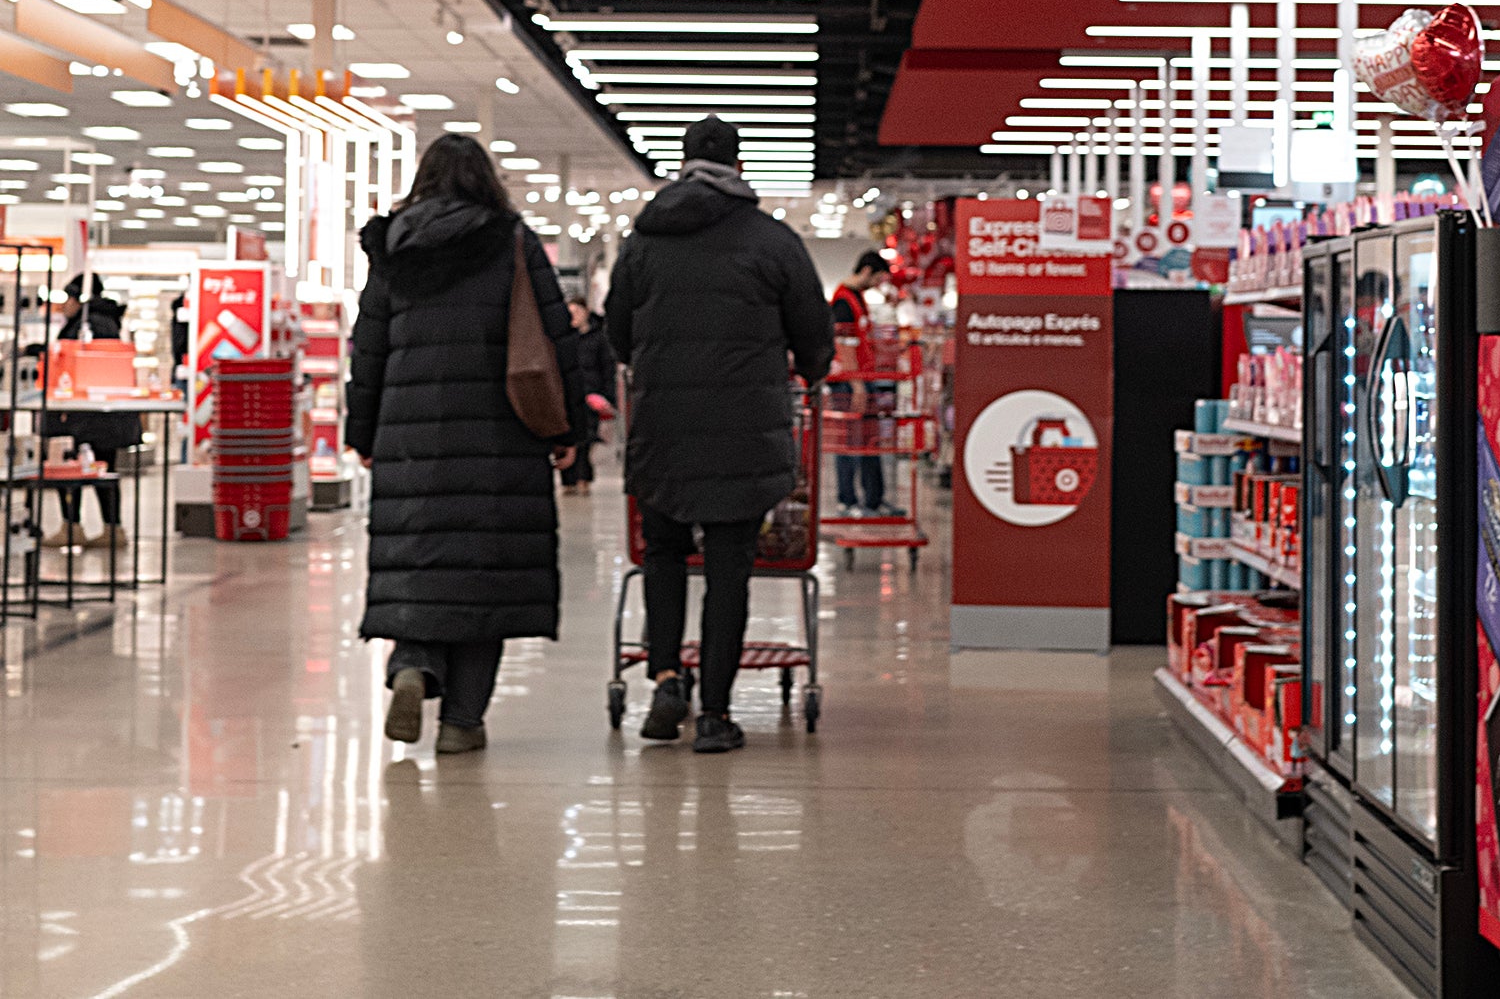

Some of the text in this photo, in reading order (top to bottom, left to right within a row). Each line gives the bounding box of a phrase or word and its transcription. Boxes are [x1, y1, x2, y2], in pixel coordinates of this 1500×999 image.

[987, 261, 1026, 276] items
[1027, 262, 1044, 276] or
[967, 312, 1100, 333] Autopago Exprés
